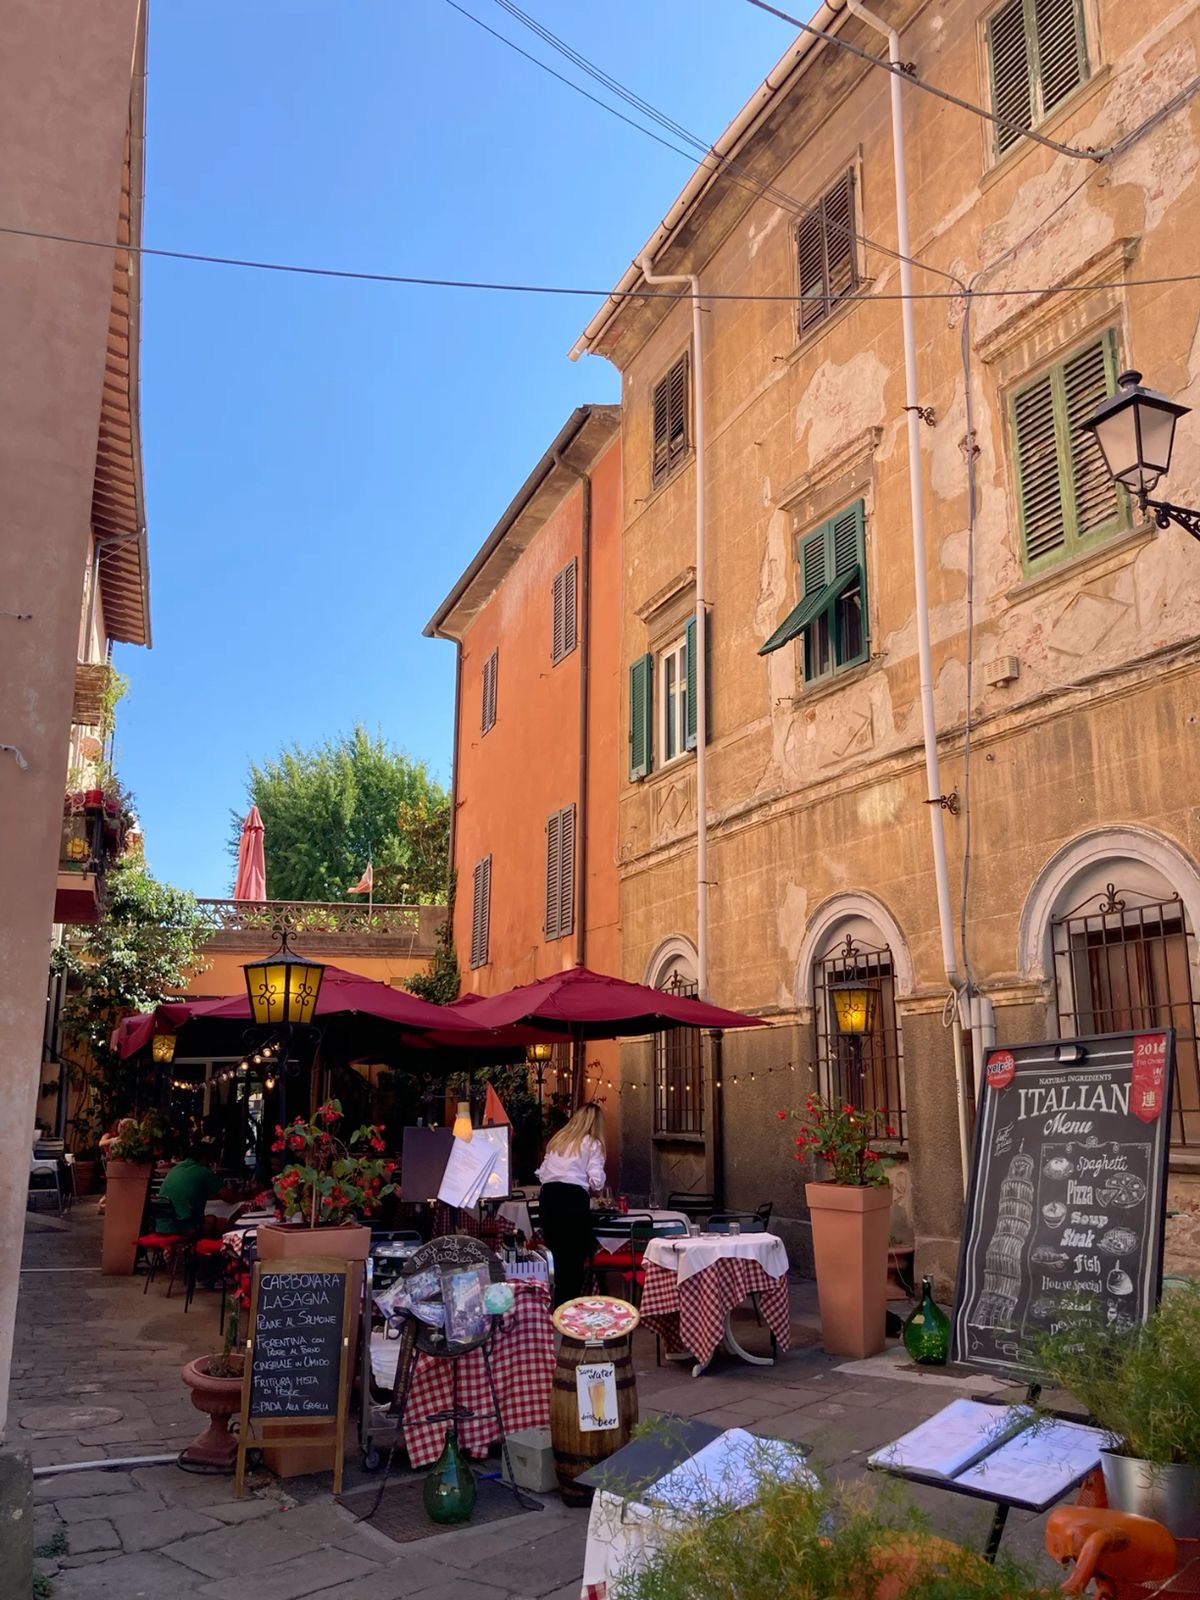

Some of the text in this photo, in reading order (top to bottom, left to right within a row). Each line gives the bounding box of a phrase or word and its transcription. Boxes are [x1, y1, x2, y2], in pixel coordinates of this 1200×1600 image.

[1039, 1074, 1112, 1085] NATURAL INGREDIENTS
[1017, 1083, 1132, 1120] ITALIAN
[1043, 1111, 1094, 1136] Menu
[1066, 1179, 1094, 1205] Pizza
[1070, 1211, 1109, 1229] Soup
[1060, 1228, 1096, 1248] Steak
[1073, 1254, 1101, 1275] Fish
[260, 1274, 341, 1290] CARBONARA
[1041, 1276, 1072, 1291] House
[263, 1291, 330, 1310] LASAGNA
[303, 1355, 331, 1368] UMIDO
